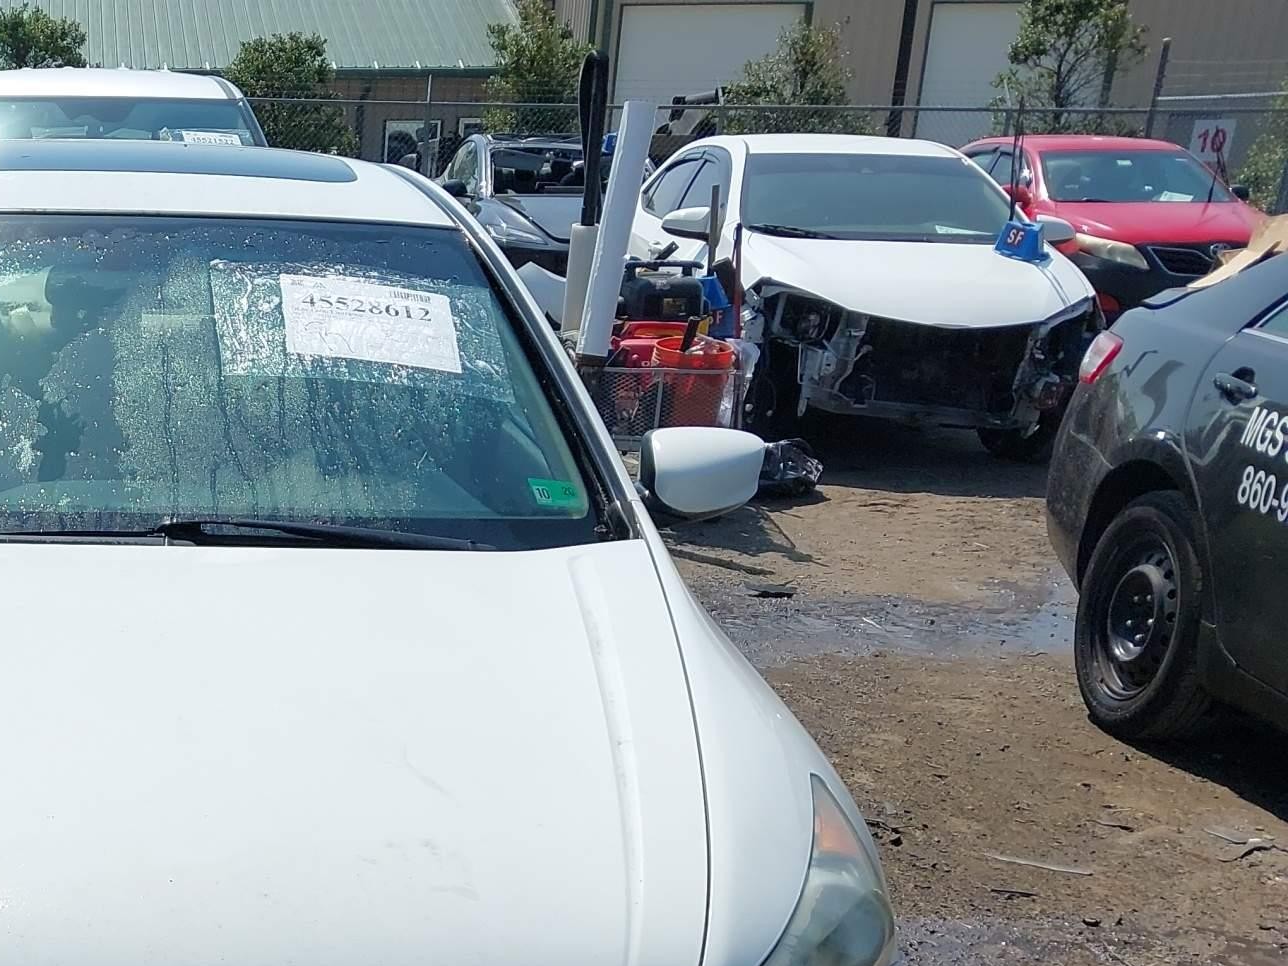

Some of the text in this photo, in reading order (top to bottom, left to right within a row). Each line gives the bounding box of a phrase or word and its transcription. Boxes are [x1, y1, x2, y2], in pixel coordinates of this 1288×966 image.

[1007, 228, 1025, 246] SF
[299, 293, 432, 322] 45528612
[535, 487, 551, 500] 10
